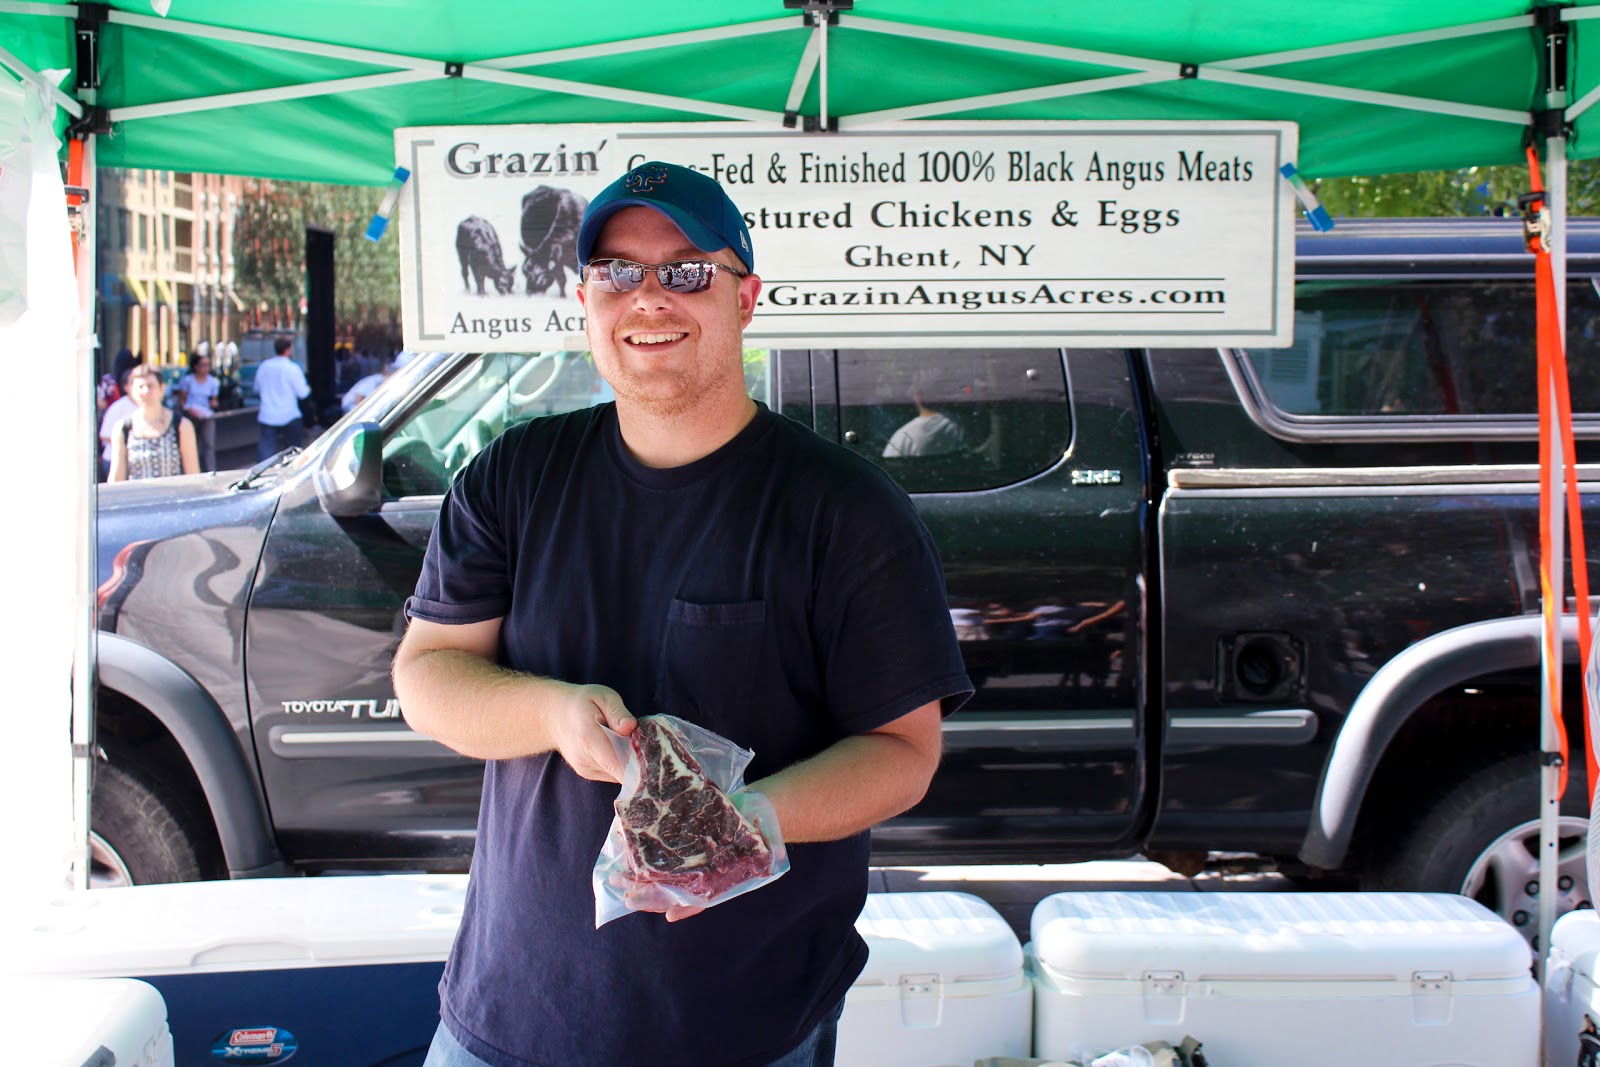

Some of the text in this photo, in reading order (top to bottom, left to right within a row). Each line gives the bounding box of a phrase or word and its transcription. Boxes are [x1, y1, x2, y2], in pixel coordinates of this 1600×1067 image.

[767, 152, 788, 185] &
[800, 151, 906, 184] Finished
[918, 151, 995, 183] 100%
[1008, 150, 1074, 182] Black
[1085, 151, 1166, 190] Angus
[1177, 150, 1254, 182] Meats
[870, 201, 1033, 228] Chickens
[1051, 200, 1079, 227] &
[1098, 200, 1181, 234] Eggs
[845, 244, 1036, 269] Ghent, NY
[450, 312, 532, 340] Angus
[281, 700, 345, 714] TOYOTA
